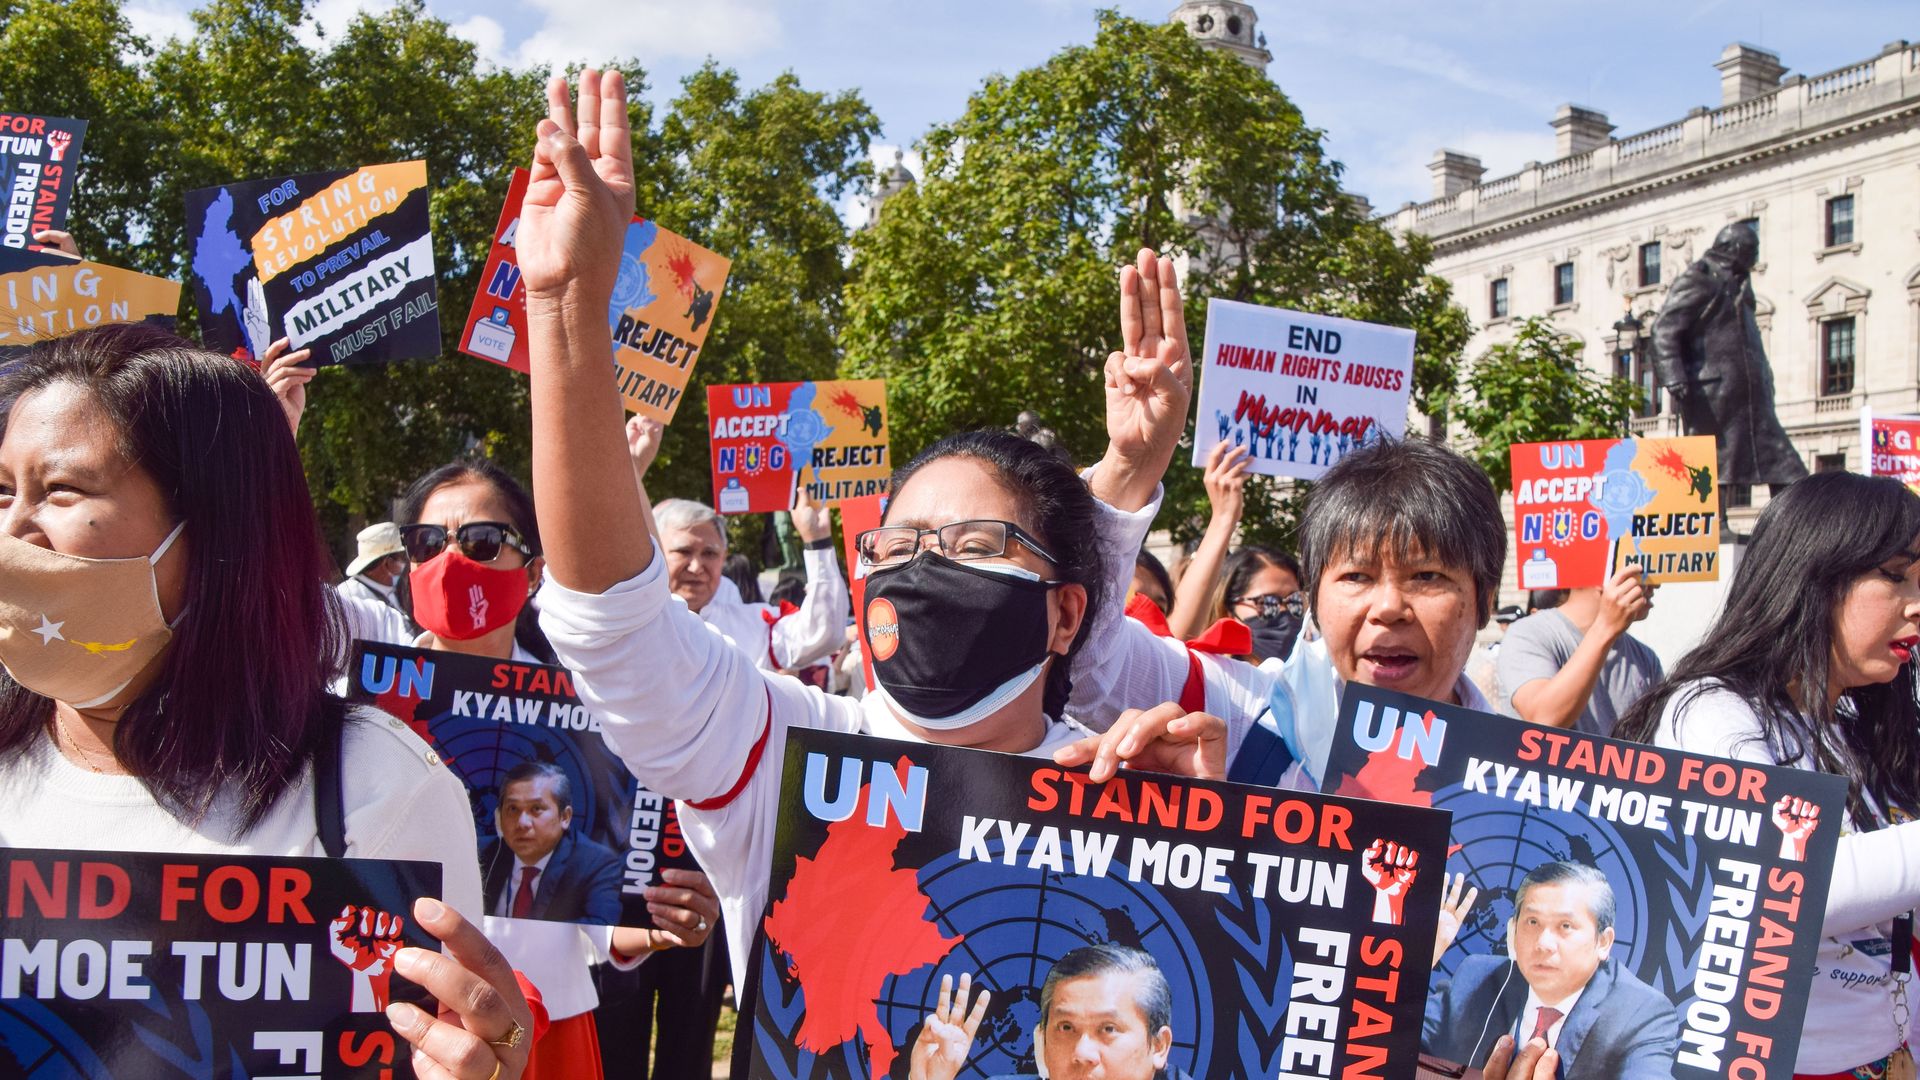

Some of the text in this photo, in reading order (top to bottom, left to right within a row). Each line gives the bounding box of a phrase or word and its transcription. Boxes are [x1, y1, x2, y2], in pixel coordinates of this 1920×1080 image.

[0, 115, 45, 134] FOR
[0, 136, 42, 156] TUN
[258, 179, 299, 214] FOR
[262, 171, 376, 250] SPRING
[262, 187, 398, 275] REVOLUTION
[290, 229, 391, 293] TO PREVAIL
[292, 255, 413, 335] MILITARY
[330, 292, 438, 363] MUST FAIL
[478, 335, 506, 351] VOTE
[613, 314, 698, 371] REJECT
[1288, 325, 1341, 354] END
[1216, 344, 1404, 392] HUMAN RIGHTS ABUSES
[733, 386, 771, 408] UN
[1234, 389, 1375, 441] Myanmar
[1296, 384, 1318, 405] IN
[714, 414, 791, 439] ACCEPT
[811, 445, 886, 468] REJECT
[1540, 444, 1585, 469] UN
[806, 479, 888, 500] MILITARY
[1516, 476, 1608, 505] ACCEPT
[1631, 512, 1716, 538] REJECT
[1625, 552, 1717, 575] MILITARY
[361, 653, 435, 699] UN
[452, 690, 544, 725] KYAW
[1353, 700, 1447, 767] UN
[804, 752, 929, 832] UN
[1517, 729, 1768, 804] STAND FOR
[1028, 768, 1353, 851] STAND FOR
[1462, 757, 1762, 847] KYAW MOE TUN
[622, 781, 664, 894] EEDOM
[958, 815, 1349, 909] KYAW MOE TUN
[160, 864, 316, 924] FOR
[1677, 858, 1761, 1072] FREEDOM
[1743, 867, 1805, 1020] STAND
[1, 939, 313, 1001] MOE TUN
[1830, 968, 1888, 989] support
[1278, 927, 1350, 1080] FREE
